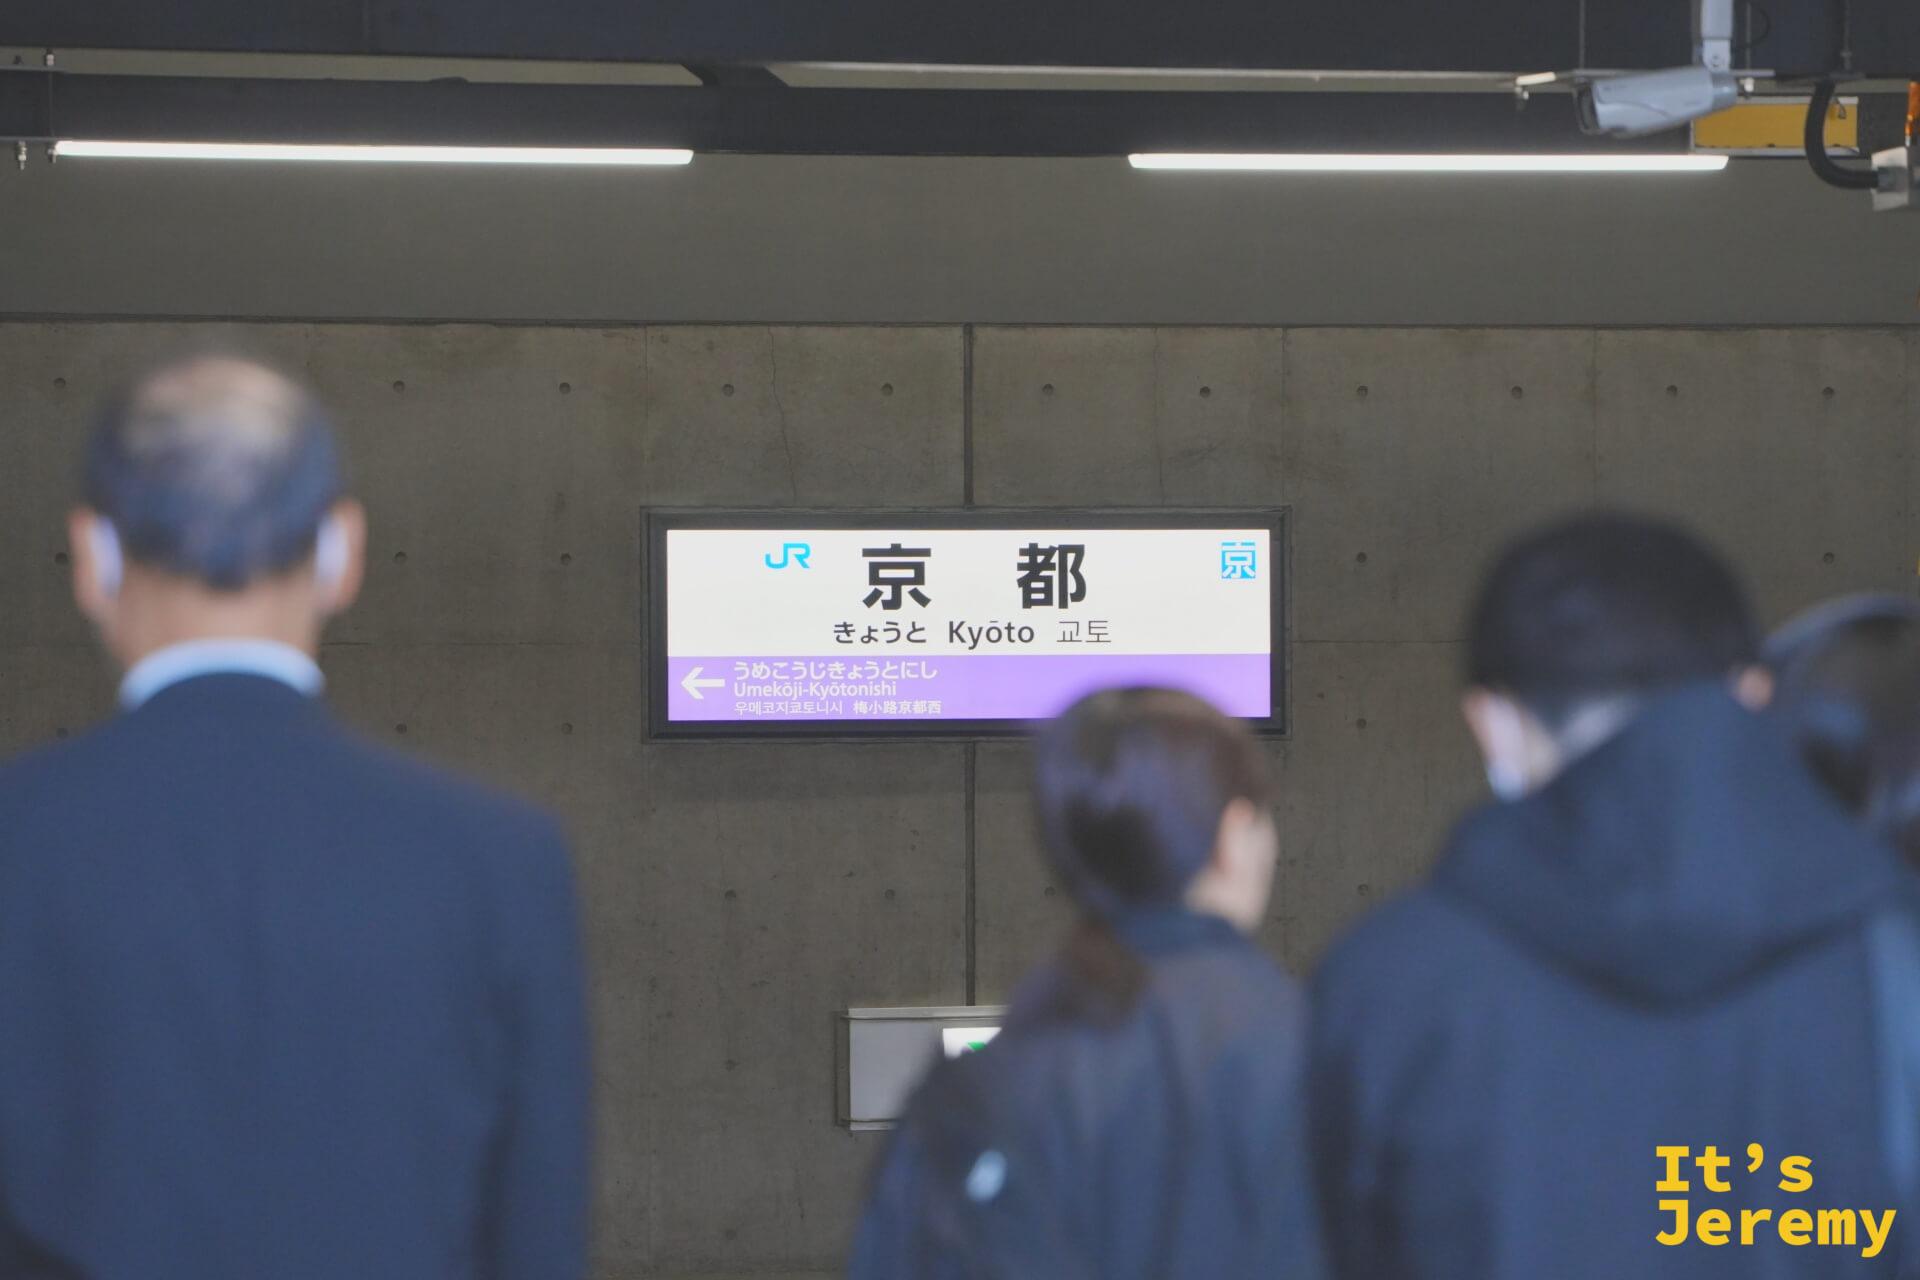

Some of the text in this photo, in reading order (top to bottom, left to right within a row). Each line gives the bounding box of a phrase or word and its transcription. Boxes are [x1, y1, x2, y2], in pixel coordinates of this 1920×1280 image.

[765, 542, 810, 569] JR
[833, 621, 927, 644] きょうと
[948, 620, 1035, 650] Kyōto
[1056, 620, 1112, 643] 교토
[733, 661, 938, 680] うめこうじきょうとにし
[733, 681, 897, 701] Umekōji-Kyōtonishi
[734, 701, 843, 715] 우메코지쿄토니시
[853, 700, 942, 715] 梅小路京都西
